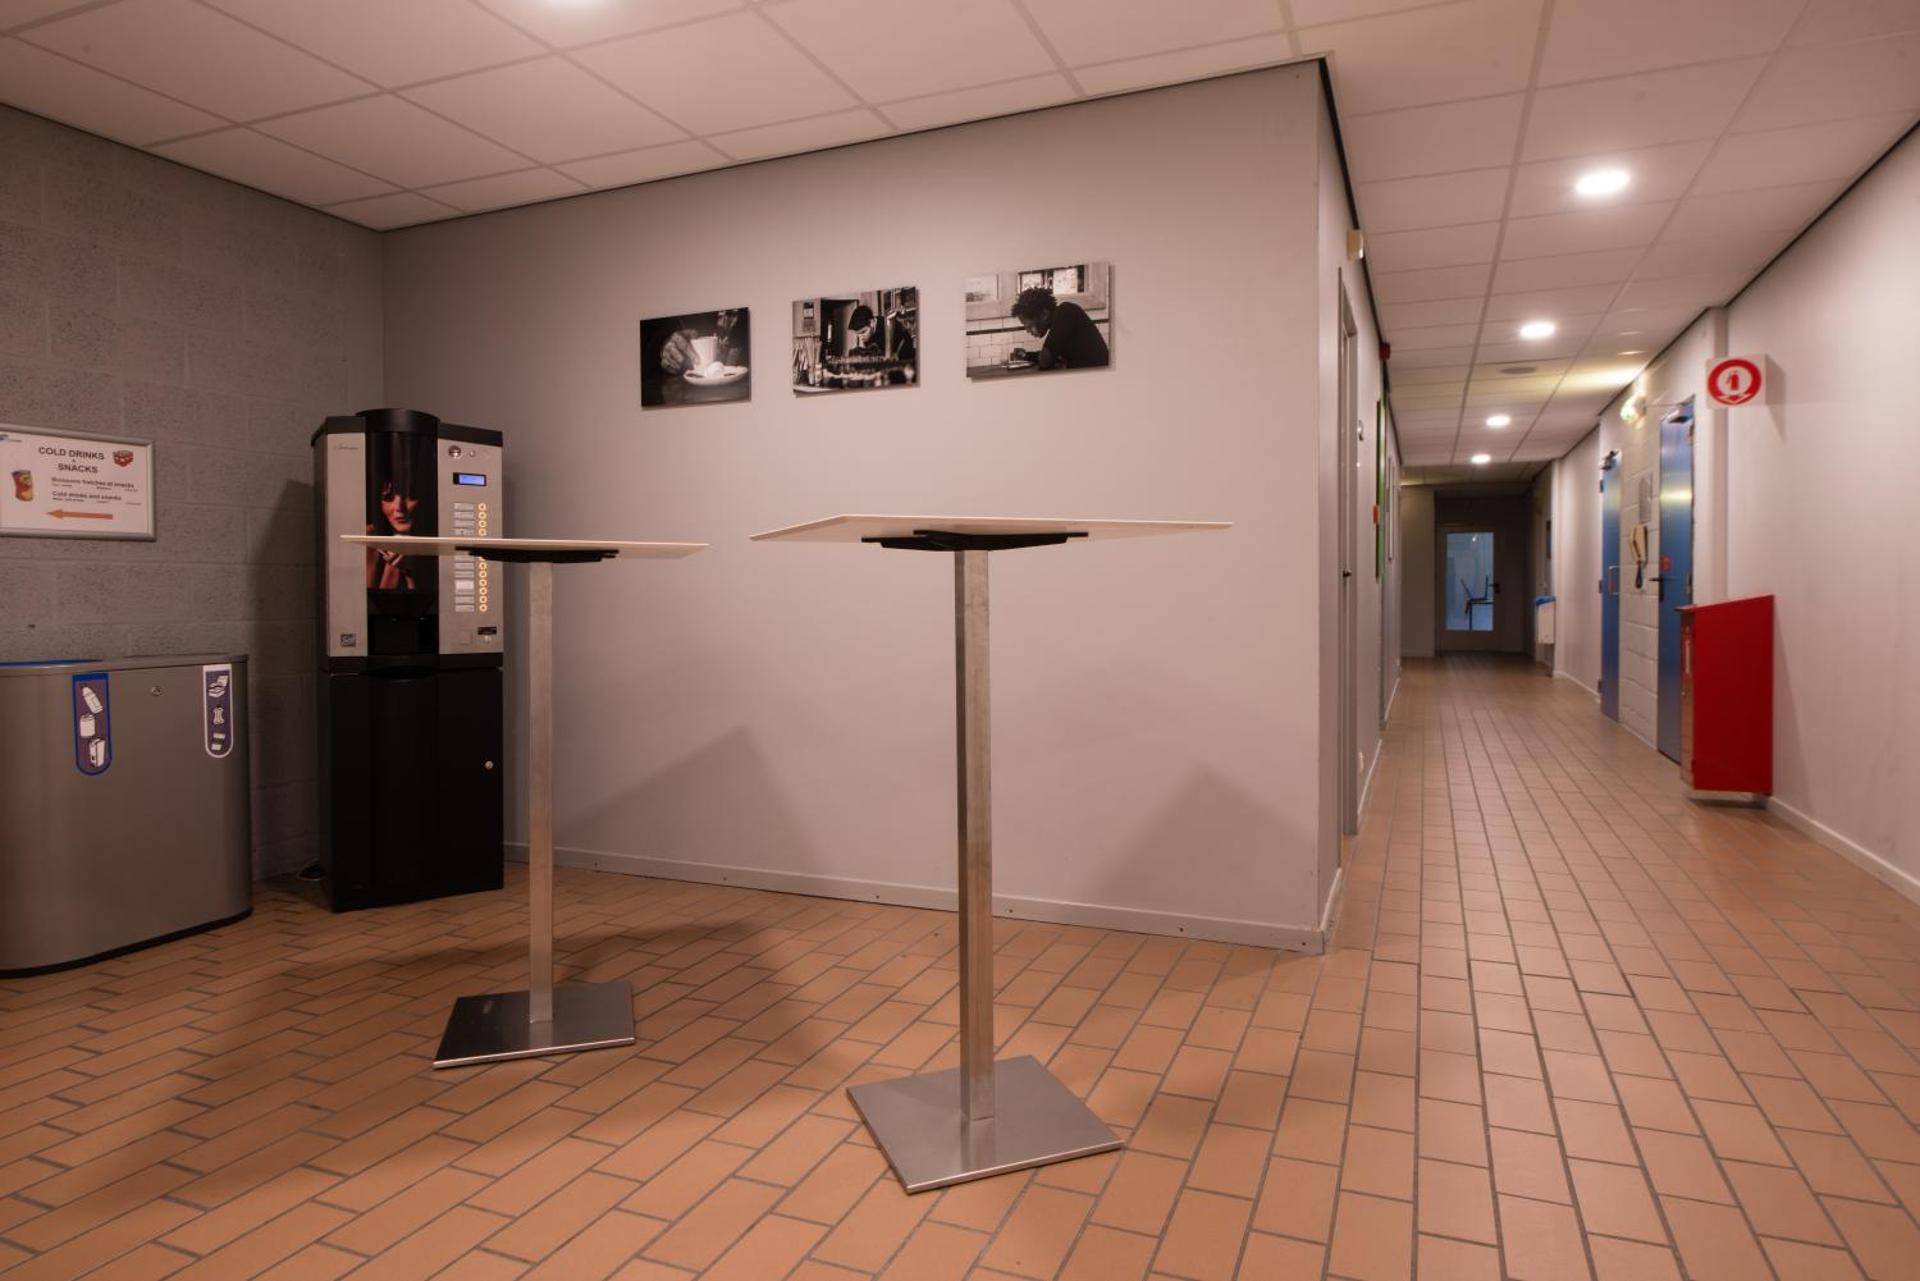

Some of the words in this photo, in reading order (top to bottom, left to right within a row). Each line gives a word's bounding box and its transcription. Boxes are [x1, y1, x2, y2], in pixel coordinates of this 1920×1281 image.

[38, 447, 66, 456] COLD
[69, 450, 105, 460] DRINKS
[58, 463, 98, 473] SNACKS
